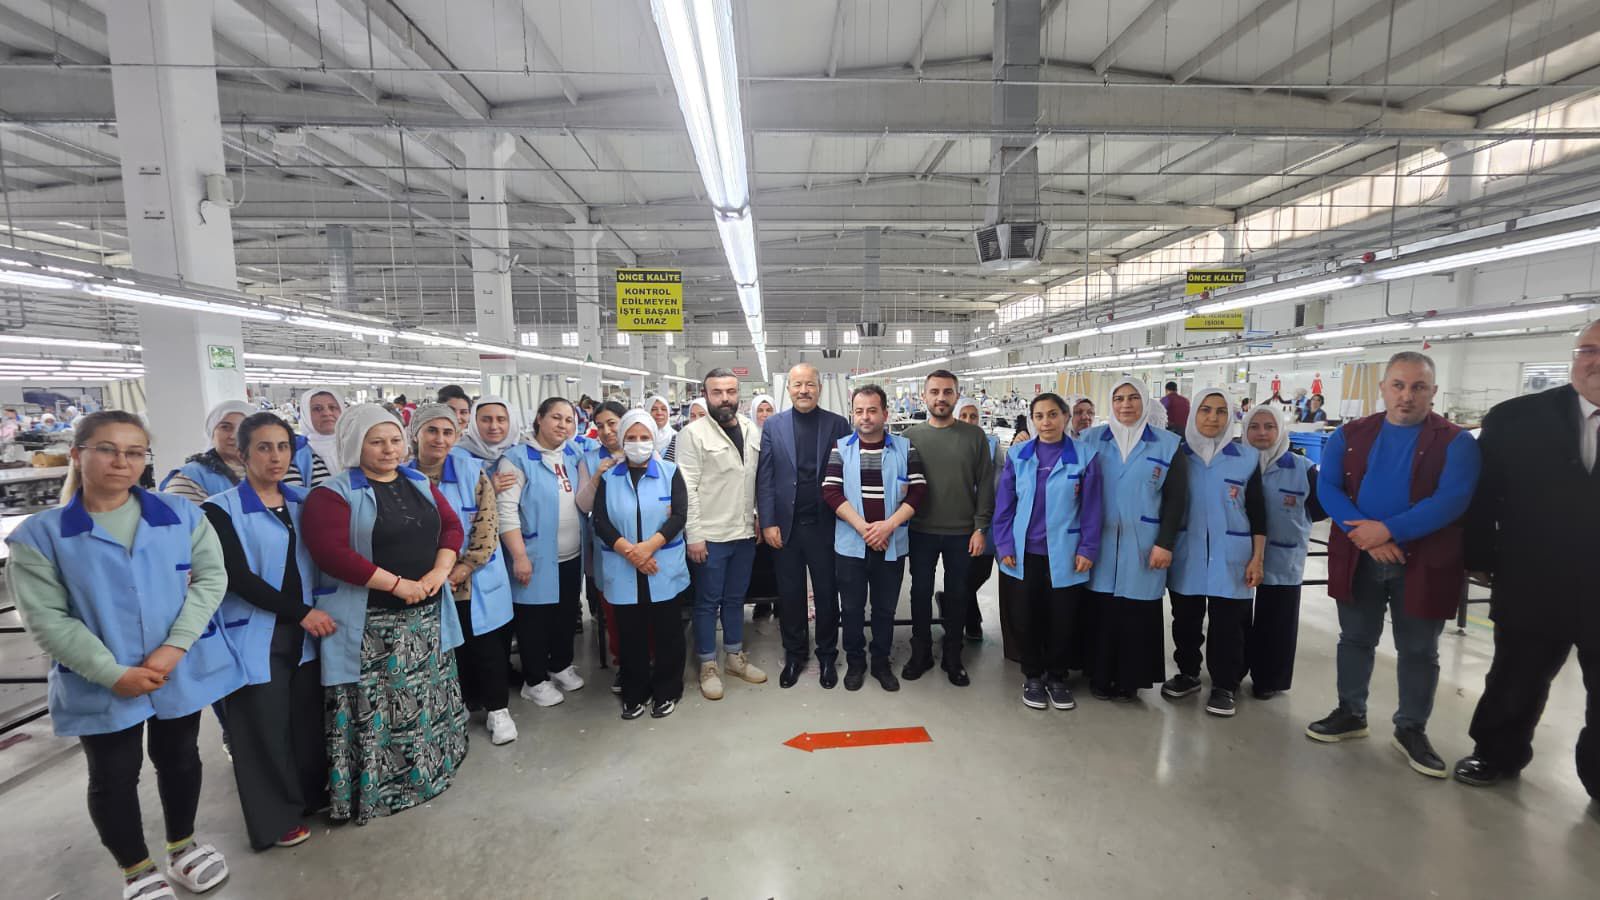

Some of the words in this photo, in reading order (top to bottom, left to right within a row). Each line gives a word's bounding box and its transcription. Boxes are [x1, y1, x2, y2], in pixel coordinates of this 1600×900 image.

[618, 272, 644, 281] ÖNCE
[646, 272, 680, 281] KALİTE
[1188, 273, 1211, 281] ÖNCE
[1214, 273, 1244, 281] KALİTE
[622, 297, 678, 305] EDİLMEYEN
[620, 307, 641, 316] İŞTE
[645, 308, 680, 316] BAŞARI
